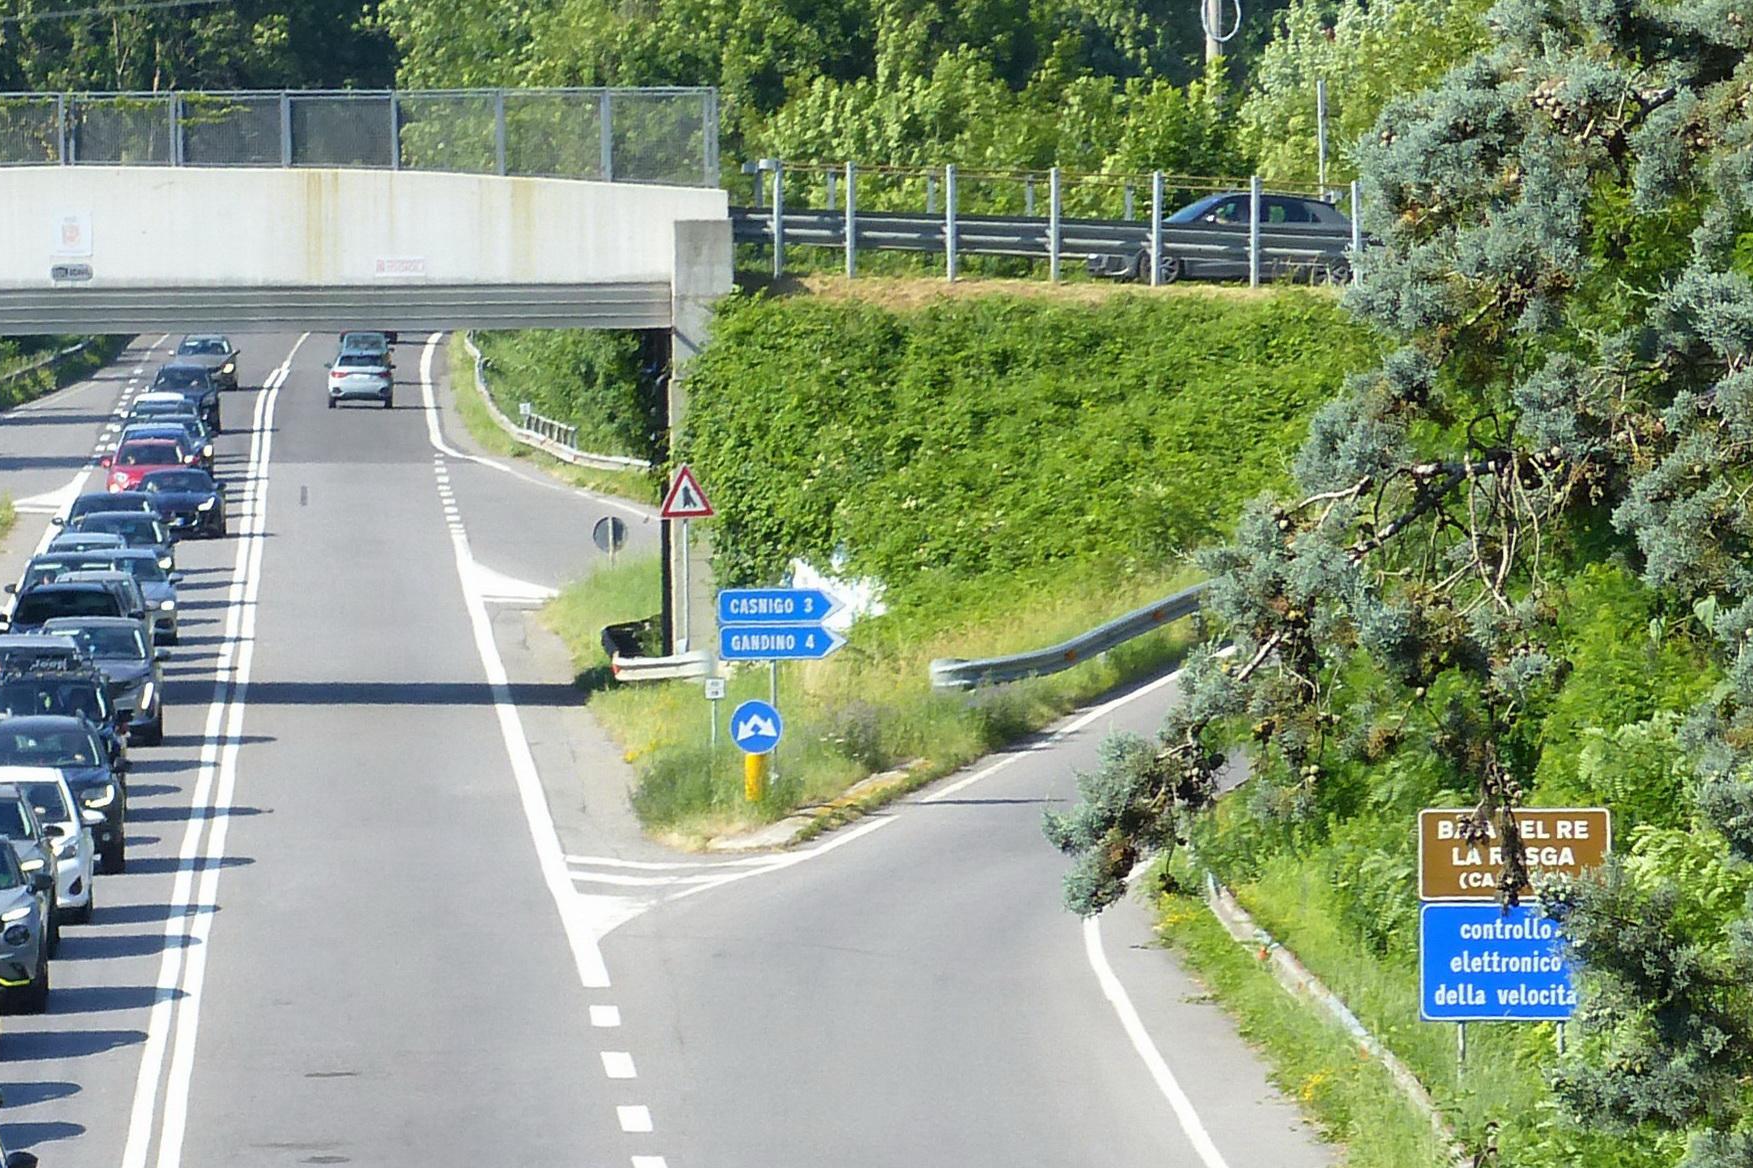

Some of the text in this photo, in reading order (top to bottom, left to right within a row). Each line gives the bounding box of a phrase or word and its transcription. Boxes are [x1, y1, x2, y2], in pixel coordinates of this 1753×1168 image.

[730, 598, 814, 614] CASNIGO 3
[731, 634, 815, 651] GANDINO 4
[1511, 820, 1550, 840] EL
[1556, 820, 1589, 840] RE
[1452, 847, 1575, 866] LA RSGA
[1460, 918, 1552, 940] controllo
[1450, 950, 1562, 973] elettronico
[1434, 983, 1486, 1006] della
